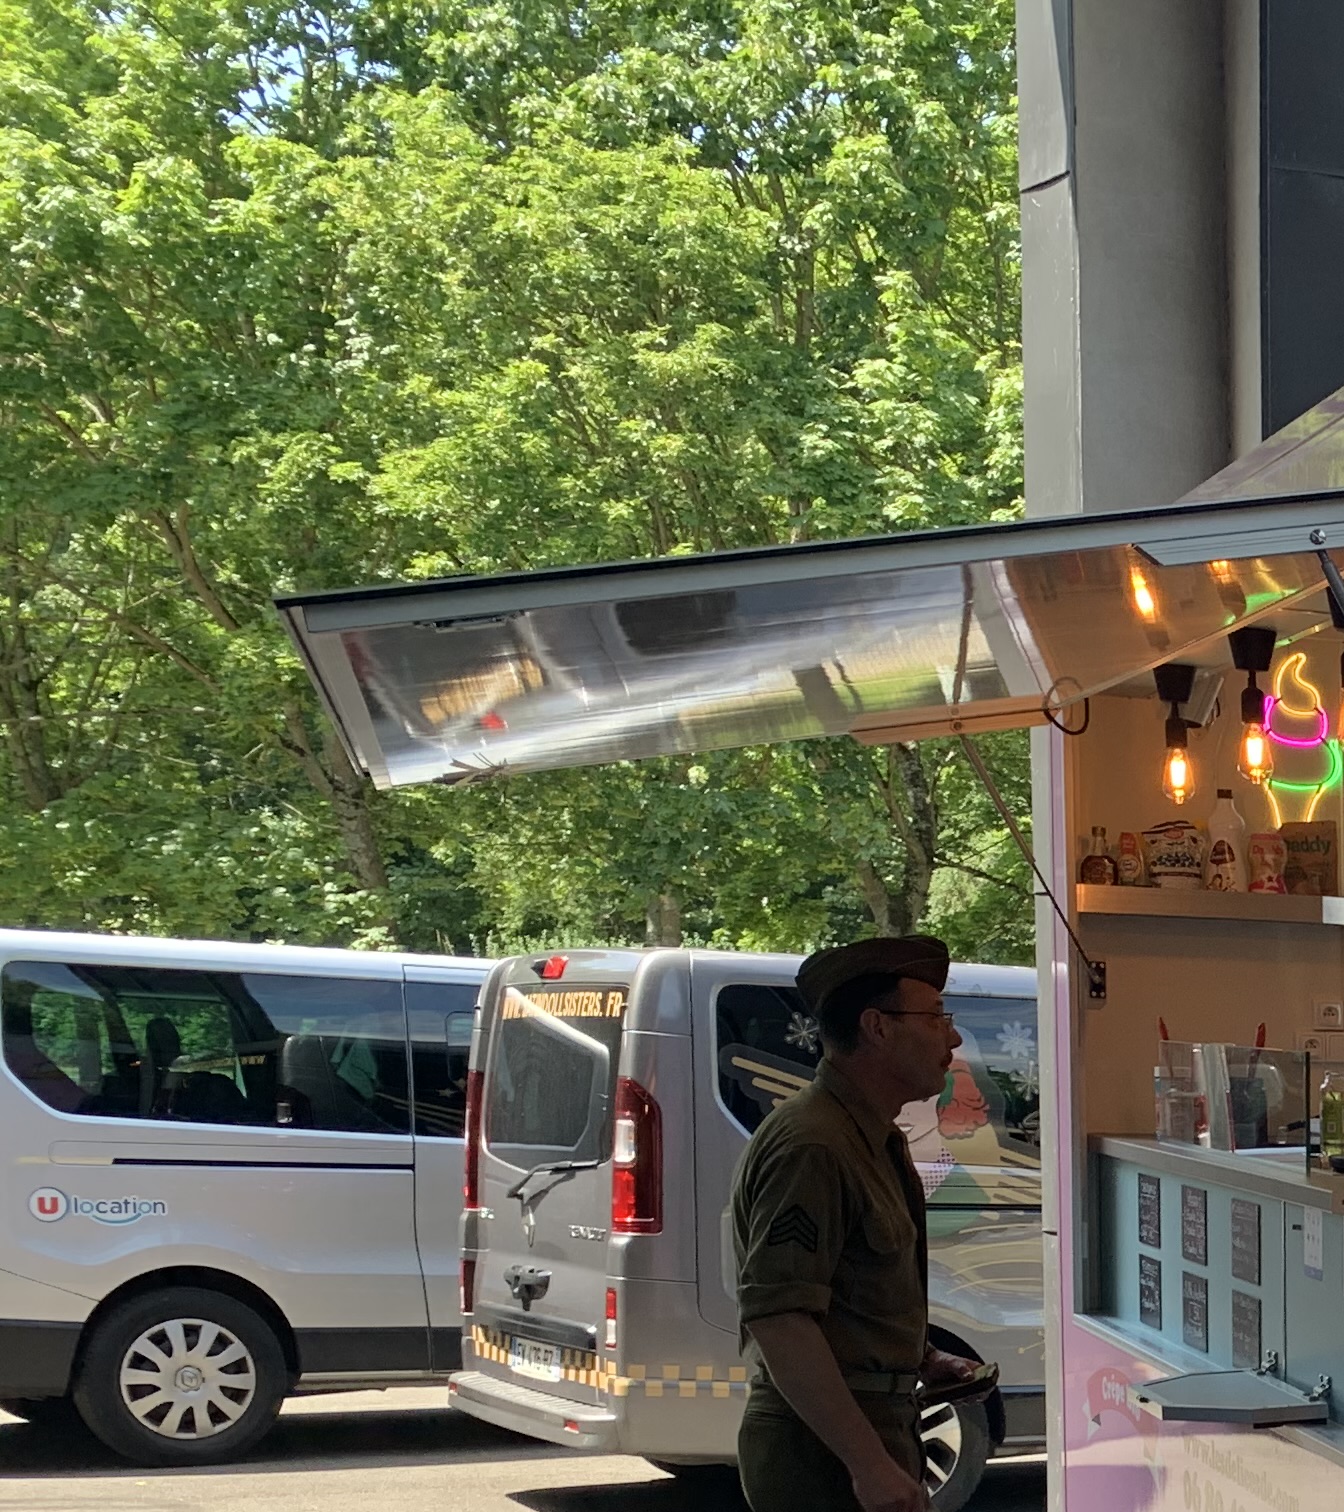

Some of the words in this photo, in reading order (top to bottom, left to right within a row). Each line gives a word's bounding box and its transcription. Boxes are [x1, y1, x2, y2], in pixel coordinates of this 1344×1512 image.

[36, 1196, 59, 1215] U
[73, 1196, 166, 1215] location
[1102, 1373, 1126, 1406] Crêpe
